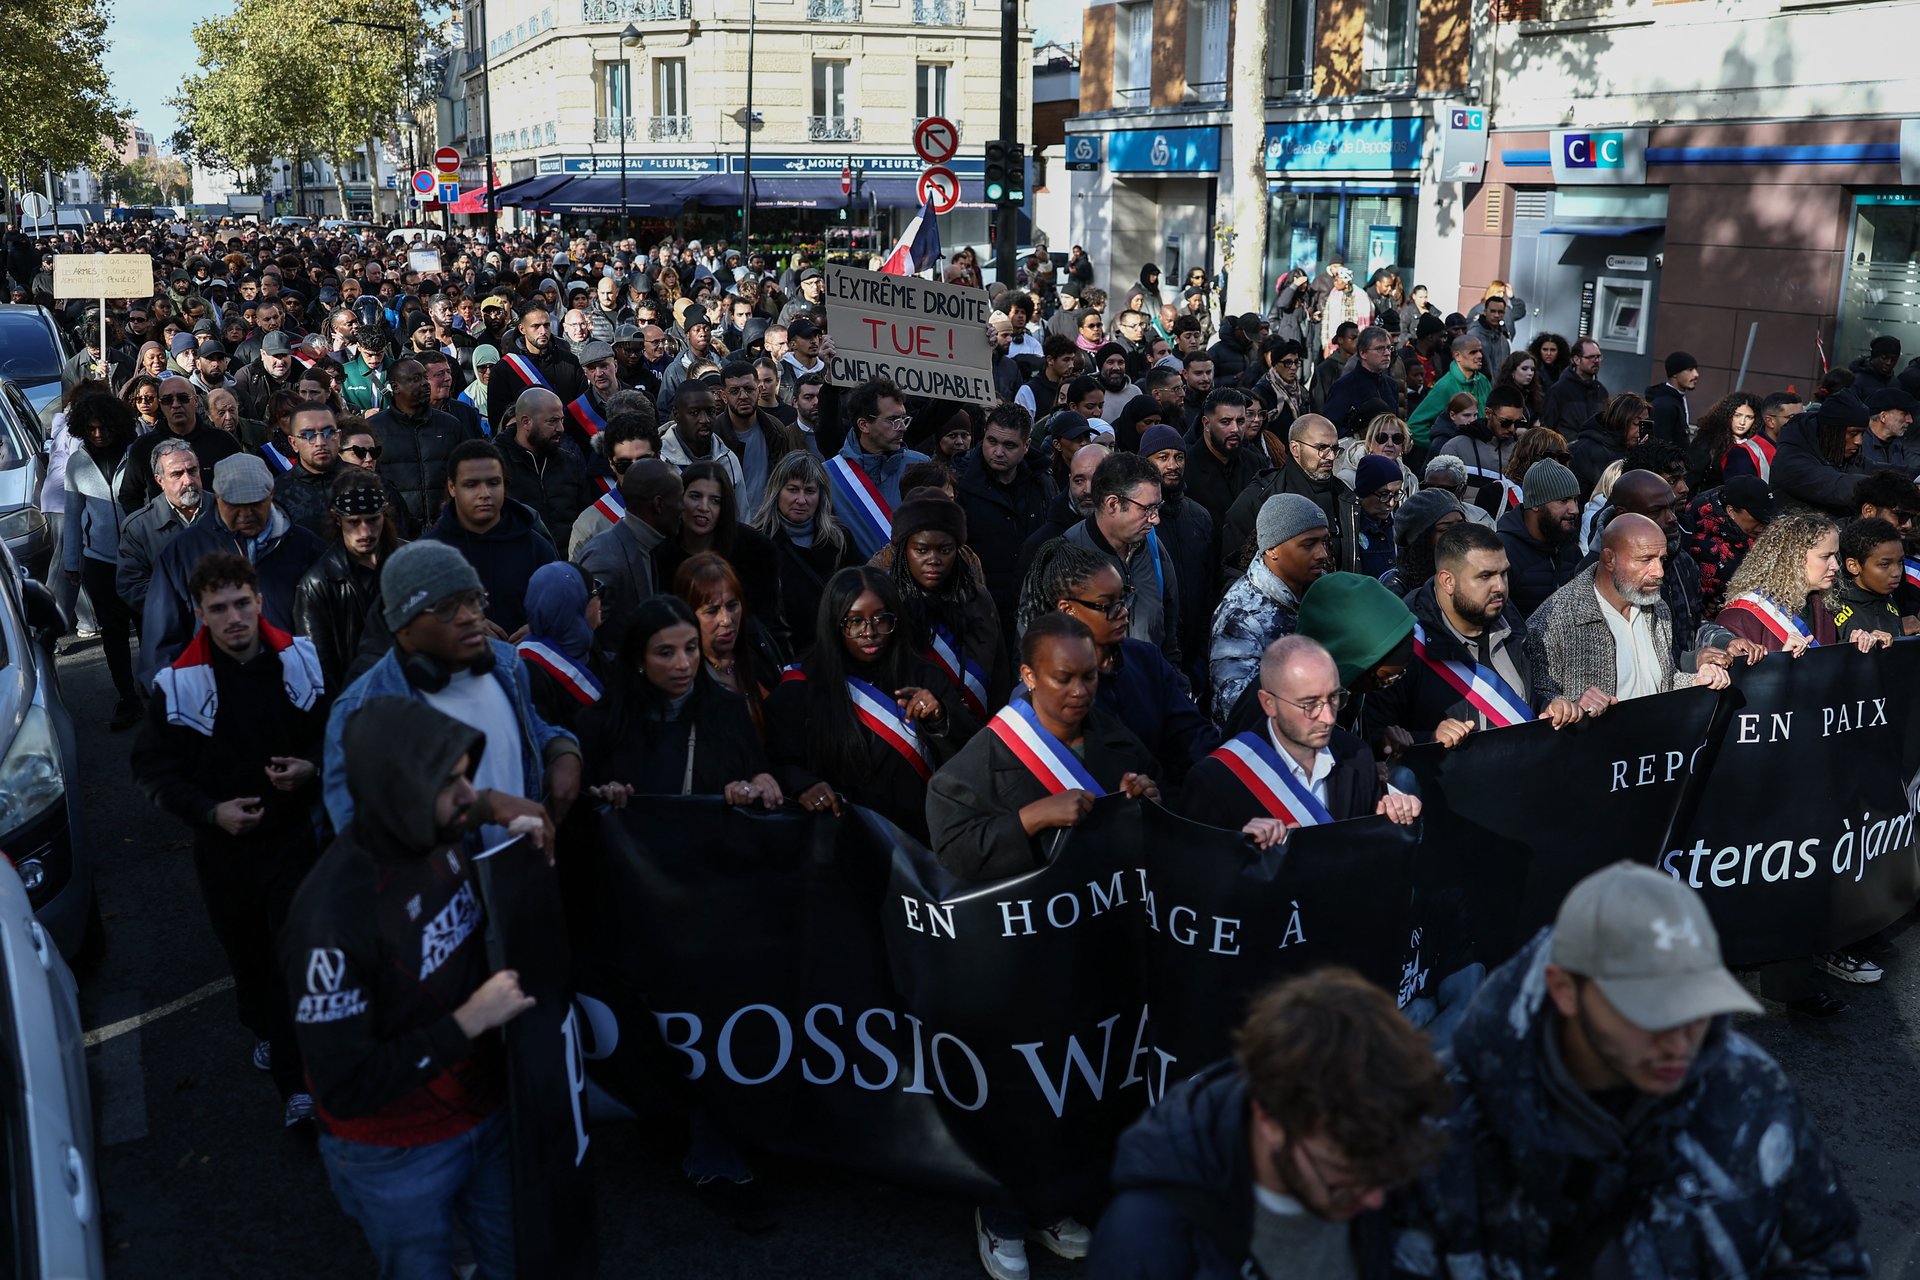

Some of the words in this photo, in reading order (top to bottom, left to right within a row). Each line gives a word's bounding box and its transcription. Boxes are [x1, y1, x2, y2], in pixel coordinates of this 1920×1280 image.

[1453, 112, 1480, 128] CIC
[1286, 140, 1311, 155] Caixa
[1313, 139, 1341, 155] Geral
[1342, 139, 1354, 154] de
[1568, 139, 1618, 163] CIC
[650, 159, 690, 168] FLEURS
[808, 159, 865, 168] MONCEAU
[871, 159, 918, 169] FLEURS
[826, 269, 917, 310] L'EXTRÊME
[862, 318, 940, 358] TUE
[894, 366, 992, 402] COUPABLE!
[1736, 711, 1794, 744] EN
[1822, 697, 1889, 738] PAIX
[900, 894, 957, 940] EN
[1277, 901, 1307, 949] À
[294, 1001, 368, 1024] ACADEMY
[297, 987, 362, 1013] ATCH
